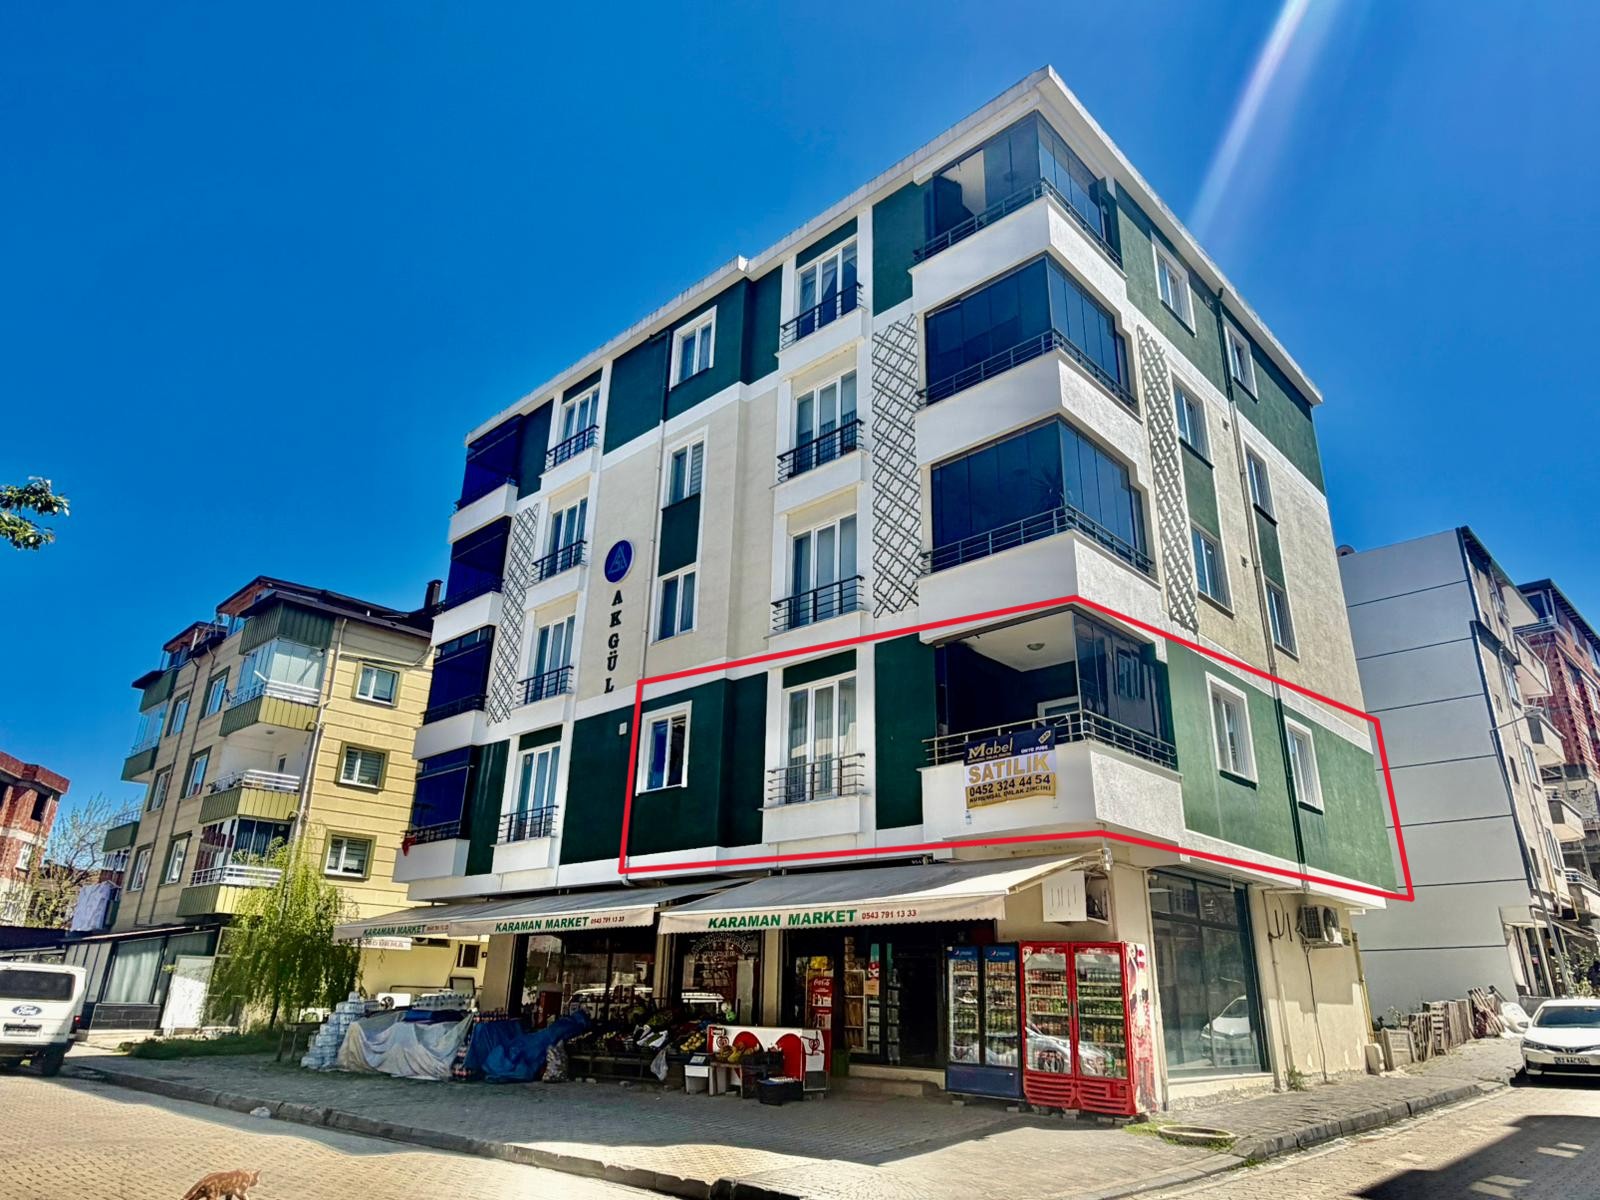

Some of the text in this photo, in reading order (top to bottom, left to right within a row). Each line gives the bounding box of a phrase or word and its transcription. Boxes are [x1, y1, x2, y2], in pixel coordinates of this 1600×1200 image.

[604, 590, 623, 694] AKGÜL
[968, 737, 1013, 759] Mabel
[969, 753, 1050, 784] SATILIK
[969, 774, 1050, 797] 0452 324 44 54
[495, 921, 542, 932] KARAMAN
[545, 917, 590, 929] MARKET
[708, 909, 917, 928] KARAMAN MARKET 0543 791 13 33
[363, 927, 396, 937] KARAMAN
[397, 925, 426, 935] MARKET
